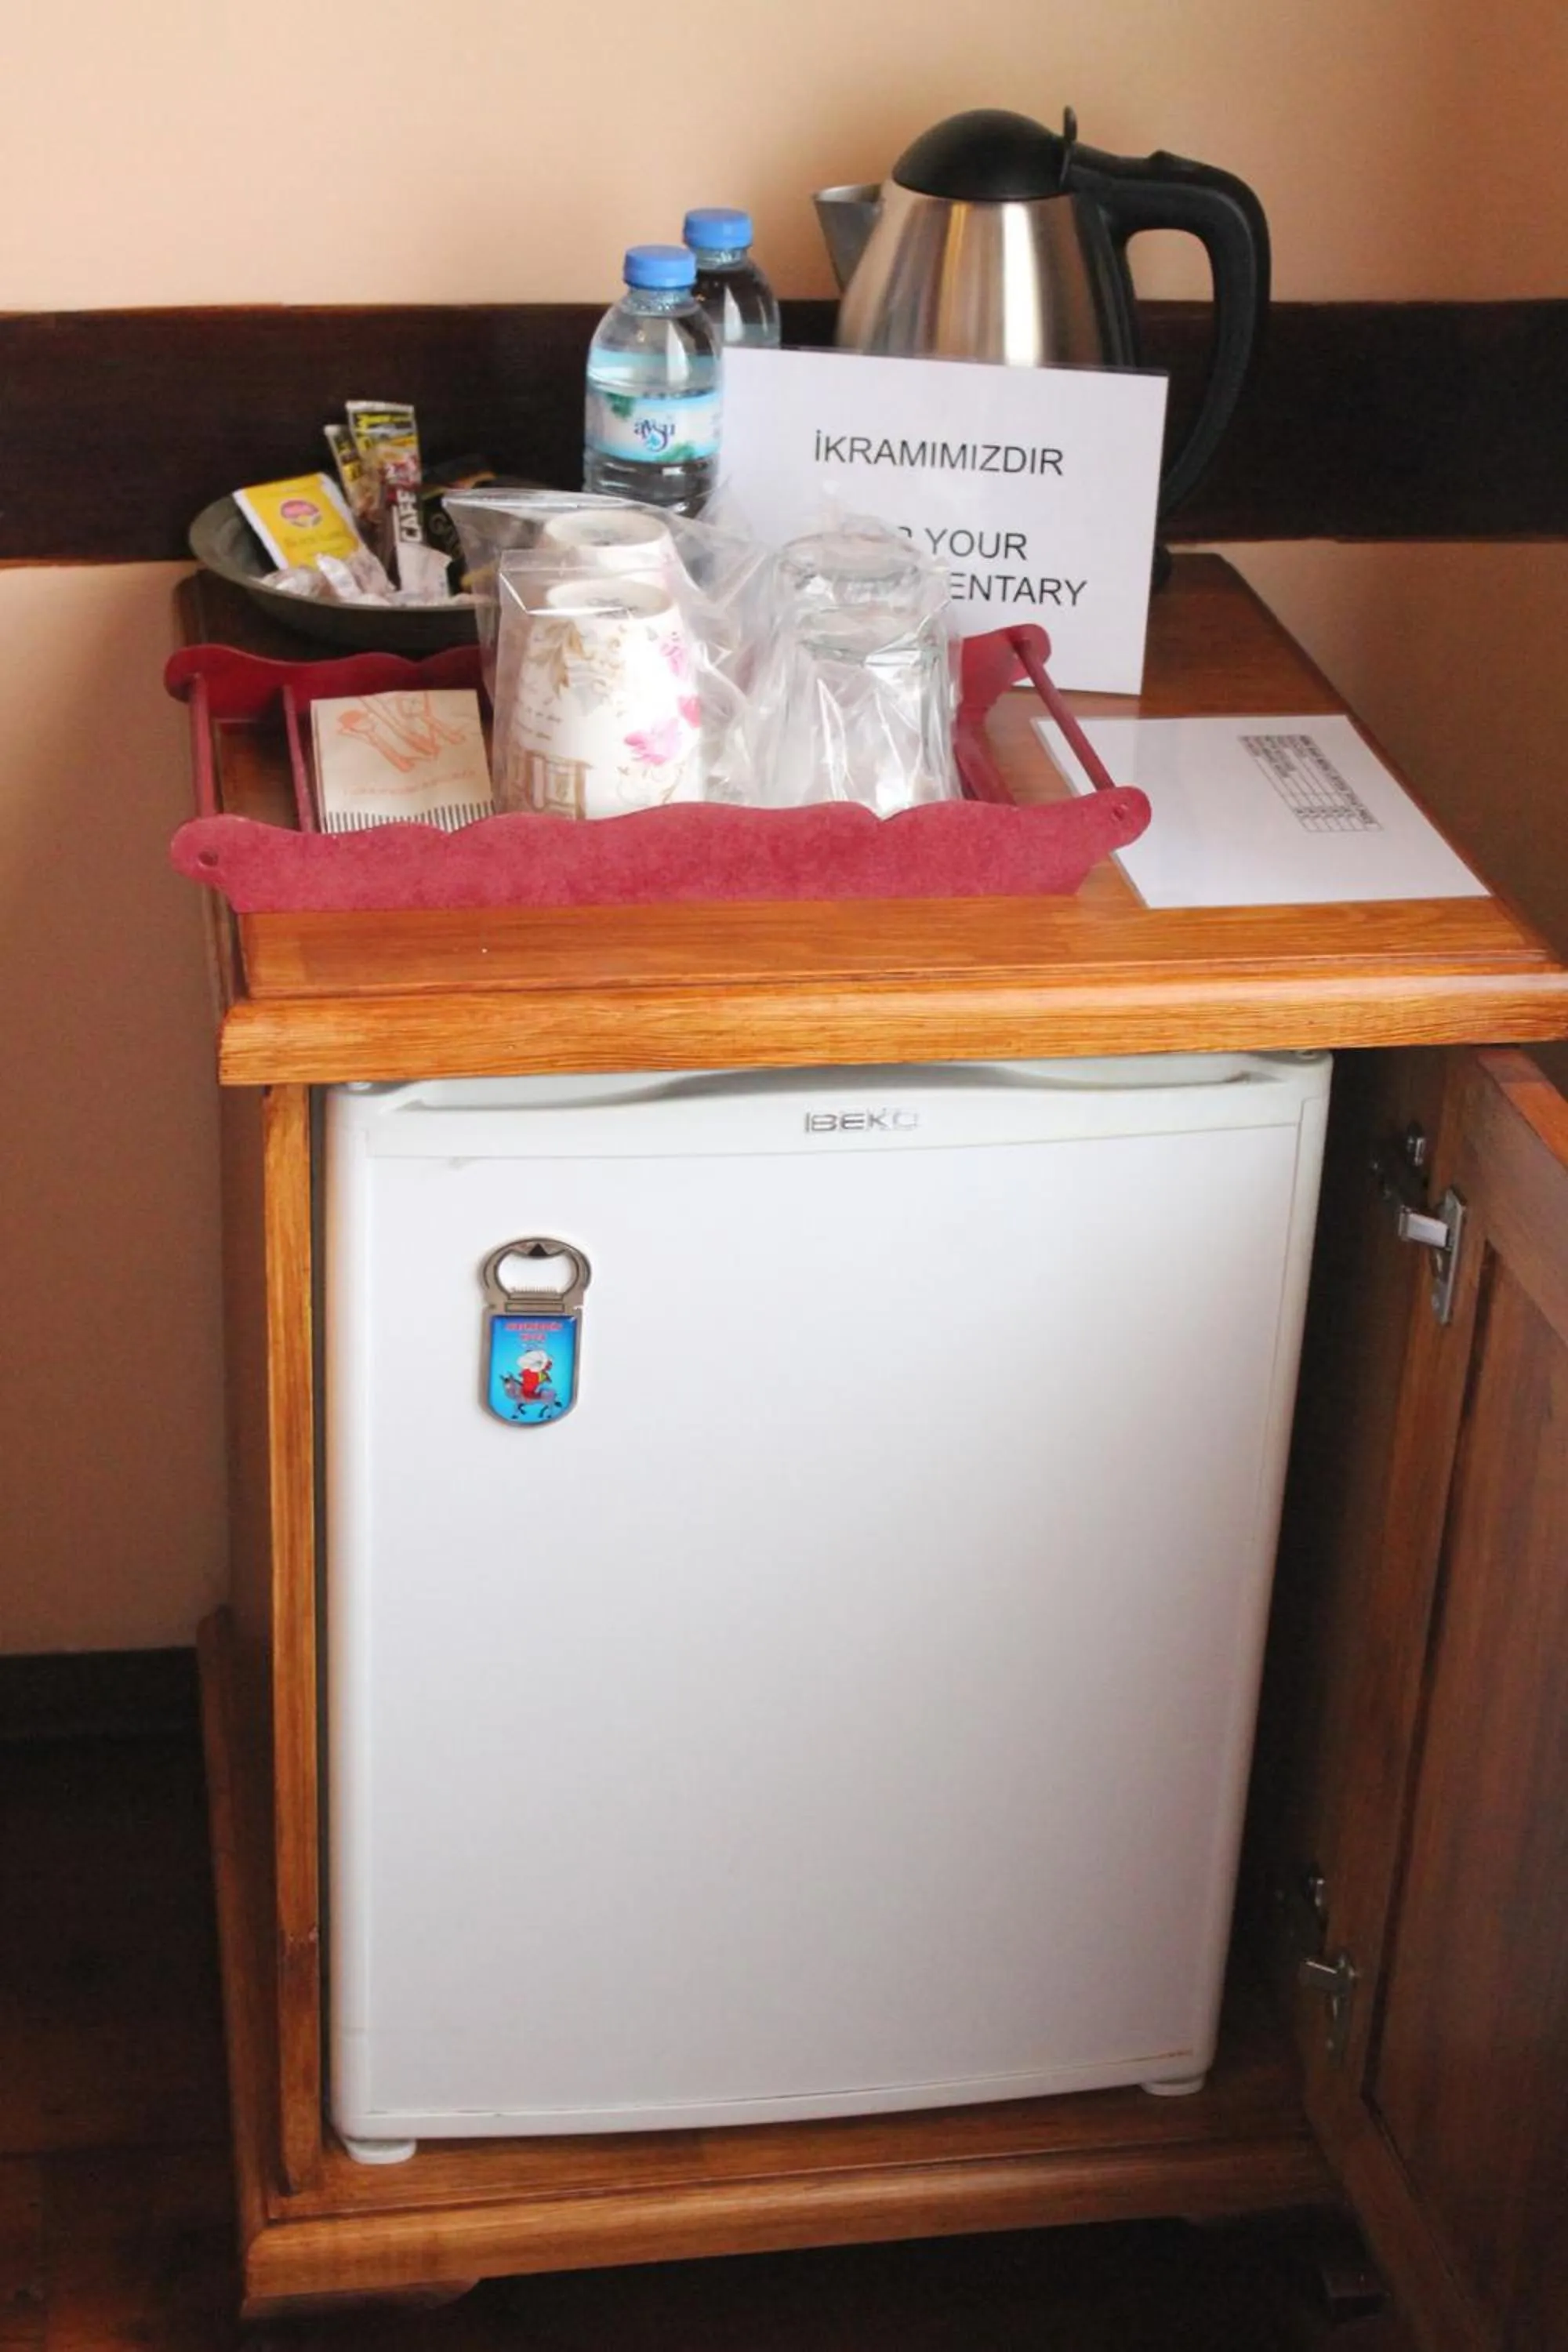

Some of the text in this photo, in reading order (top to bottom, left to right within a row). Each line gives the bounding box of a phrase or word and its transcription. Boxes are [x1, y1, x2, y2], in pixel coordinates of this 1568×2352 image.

[815, 430, 1064, 476] İKRAMIMIZDIR
[924, 528, 1027, 561] YOUR
[949, 572, 1088, 607] ENTARY
[804, 1109, 919, 1133] BEKO
